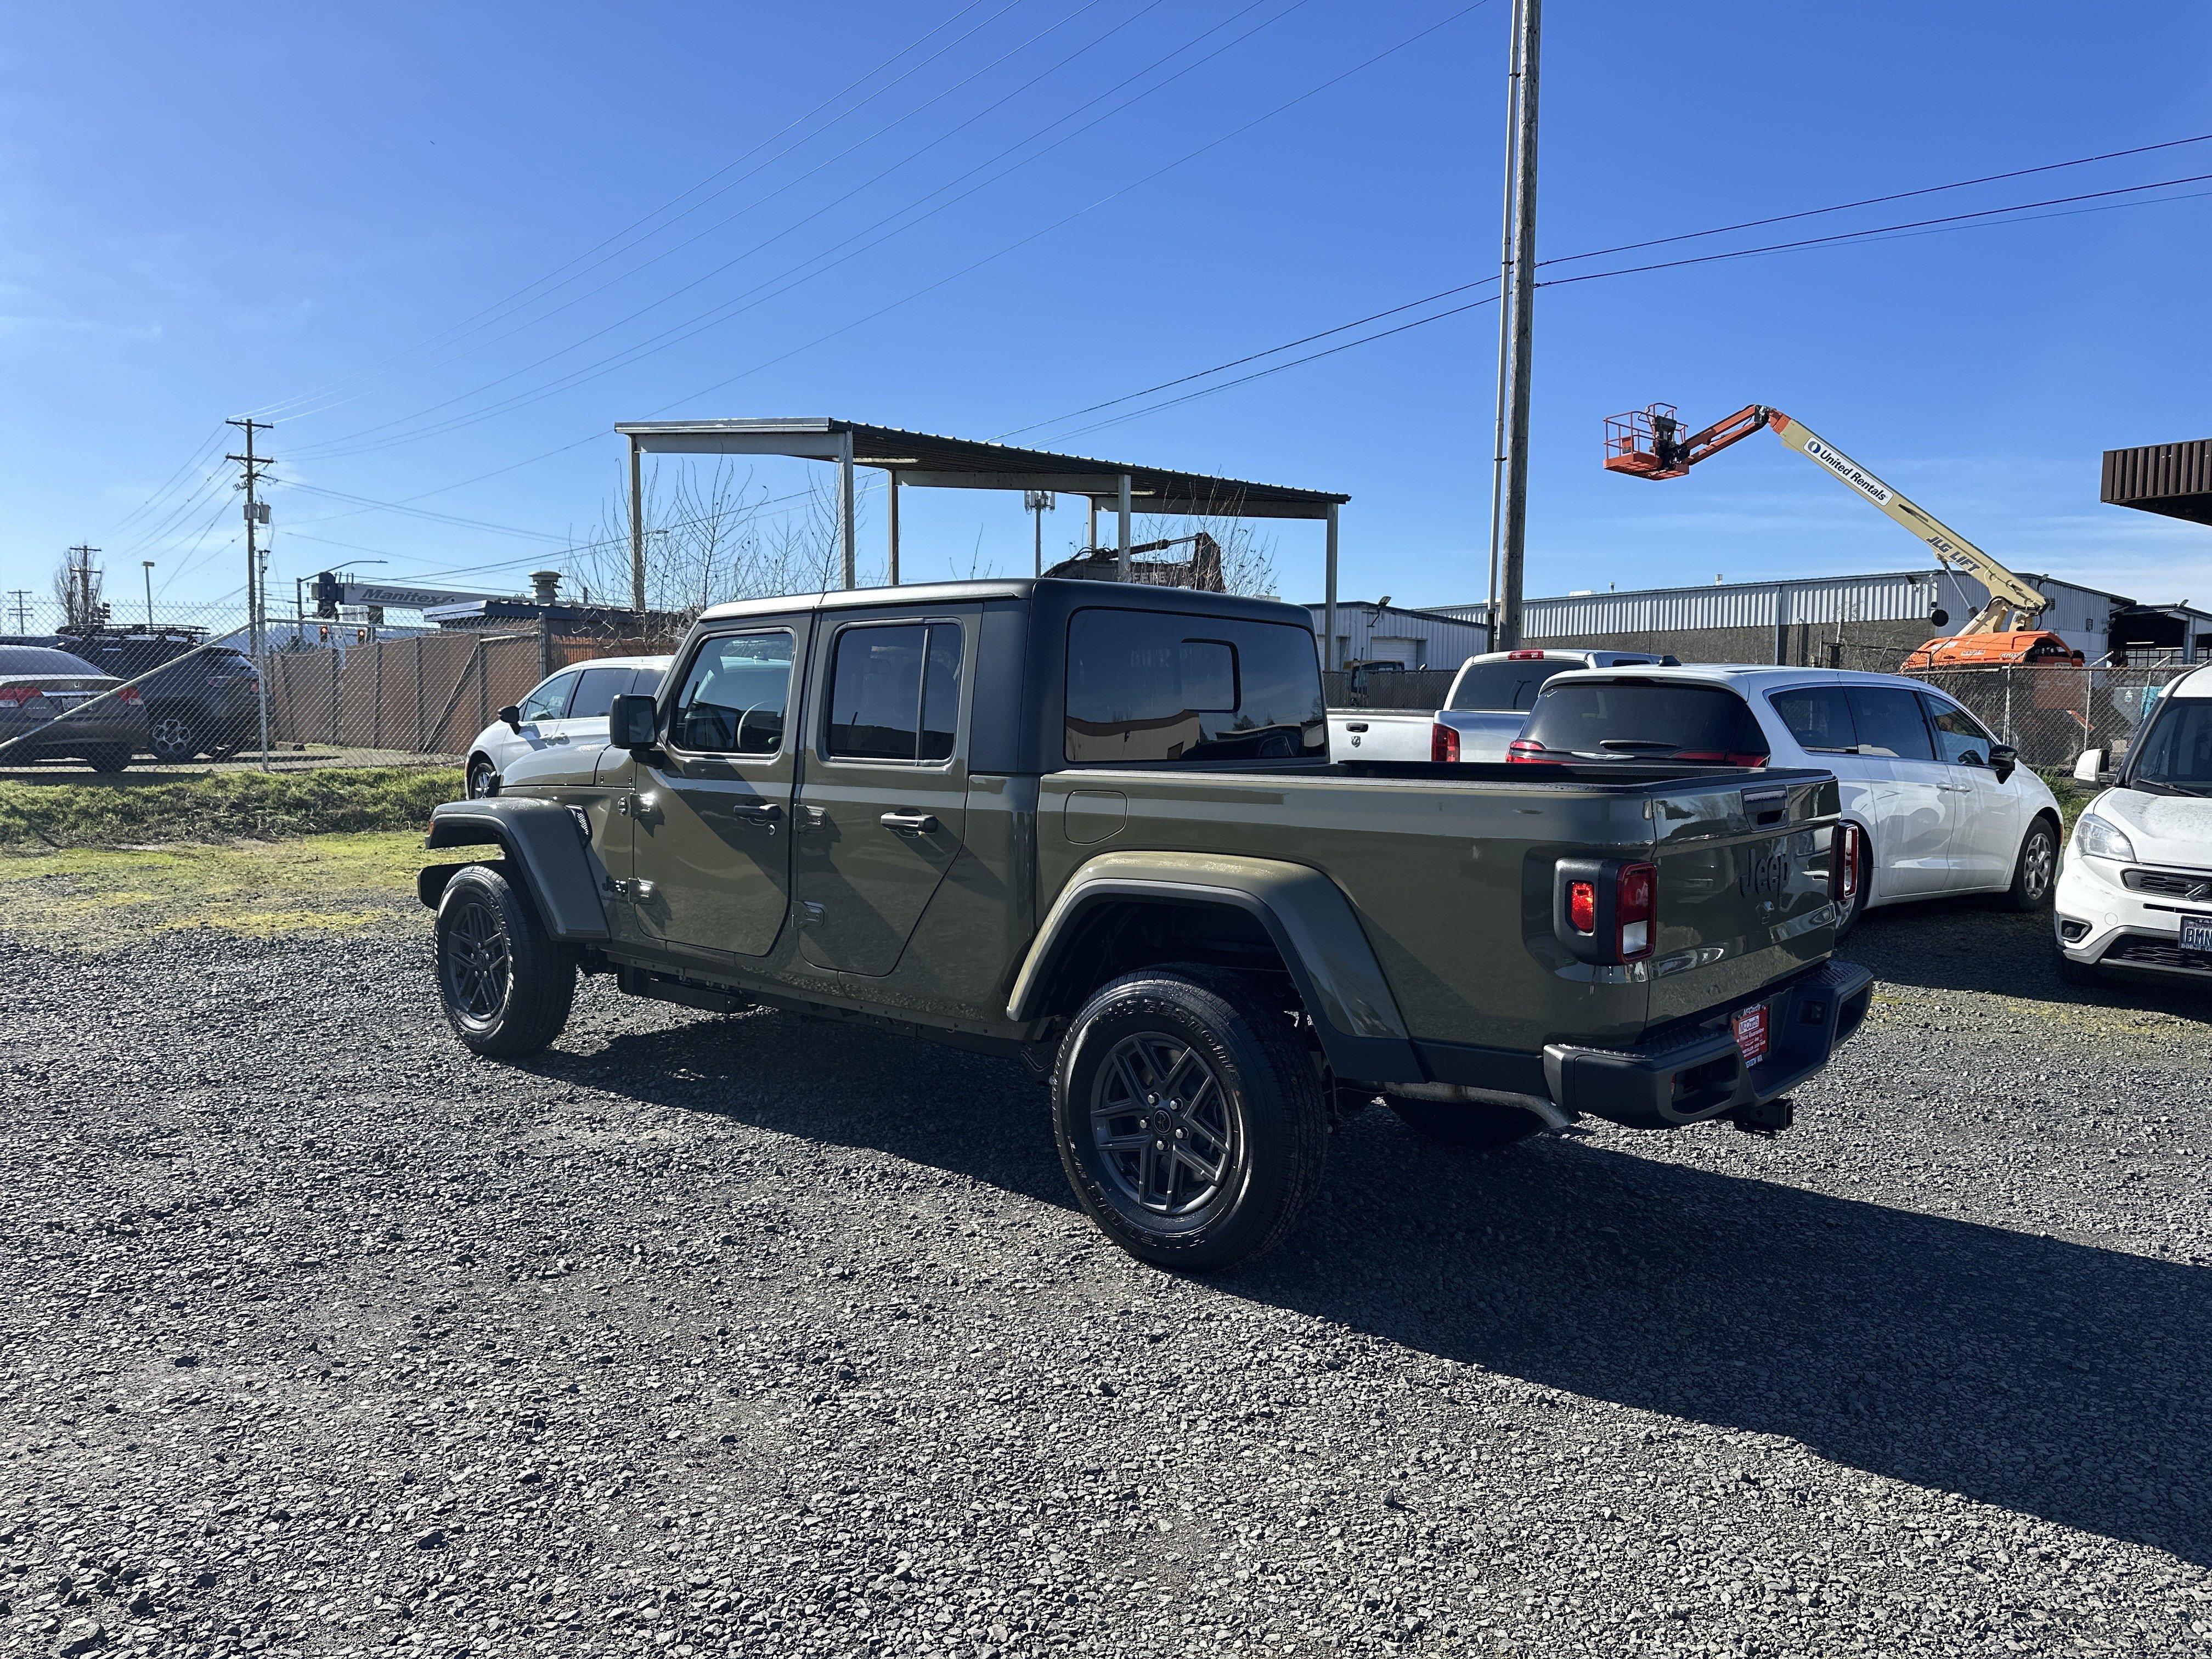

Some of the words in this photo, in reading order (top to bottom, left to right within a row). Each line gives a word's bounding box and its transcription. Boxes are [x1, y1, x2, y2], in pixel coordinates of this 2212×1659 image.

[1820, 449, 1853, 476] United
[1850, 471, 1886, 500] Rentals
[1926, 536, 1953, 553] JLG
[1949, 550, 1981, 572] LIFT
[362, 588, 441, 604] Manitex
[1132, 571, 1167, 585] EERE
[1739, 849, 1790, 899] Jeep
